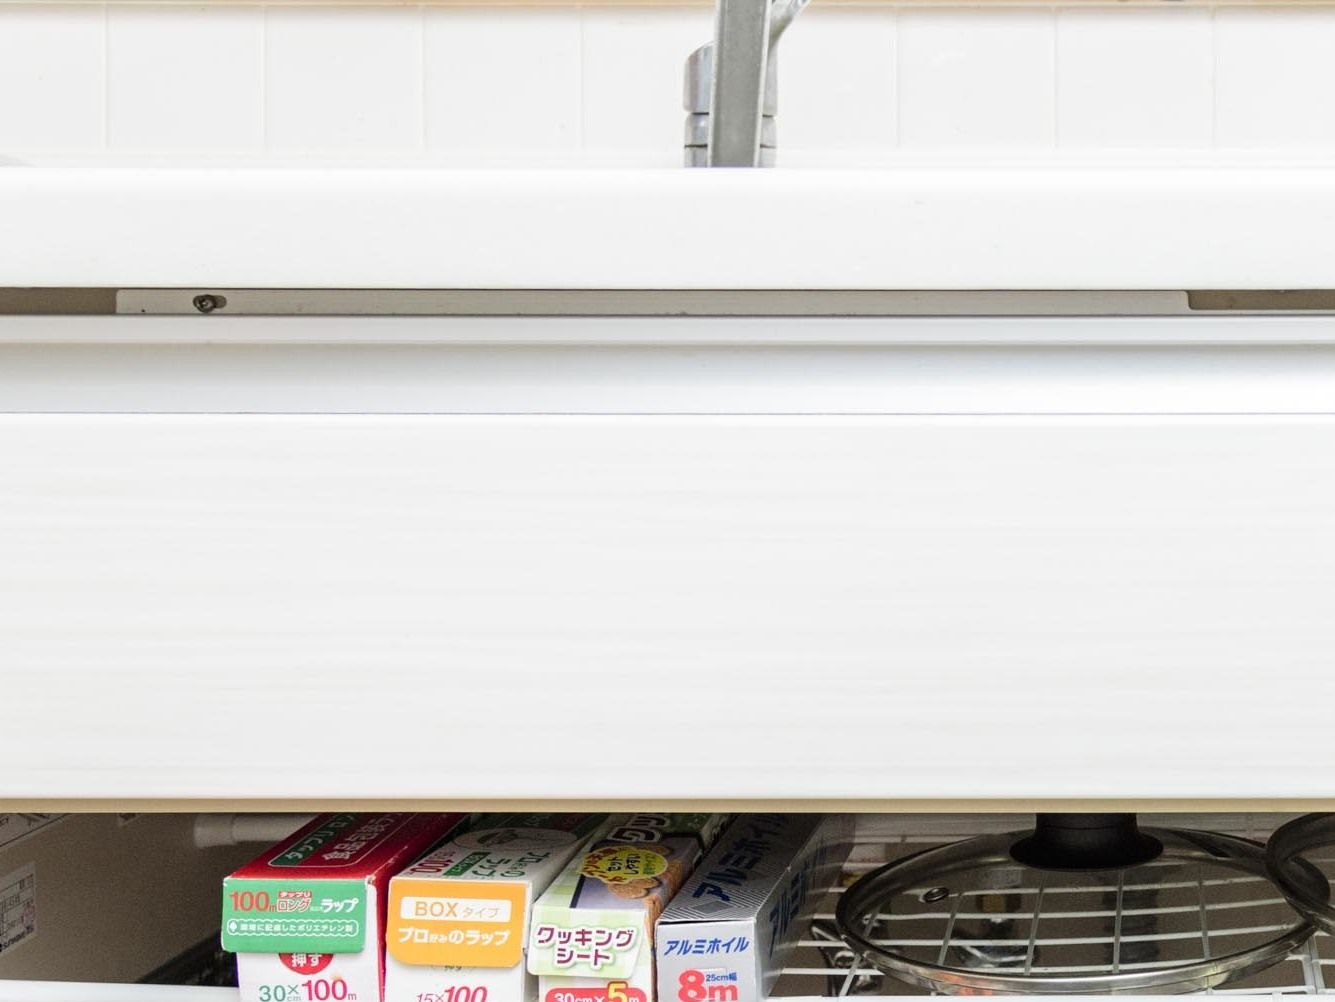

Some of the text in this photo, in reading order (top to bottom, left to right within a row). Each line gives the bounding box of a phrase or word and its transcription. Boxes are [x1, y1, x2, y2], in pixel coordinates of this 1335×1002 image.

[537, 927, 634, 948] クッキング
[664, 936, 749, 956] アルミホイル
[556, 948, 610, 967] シート
